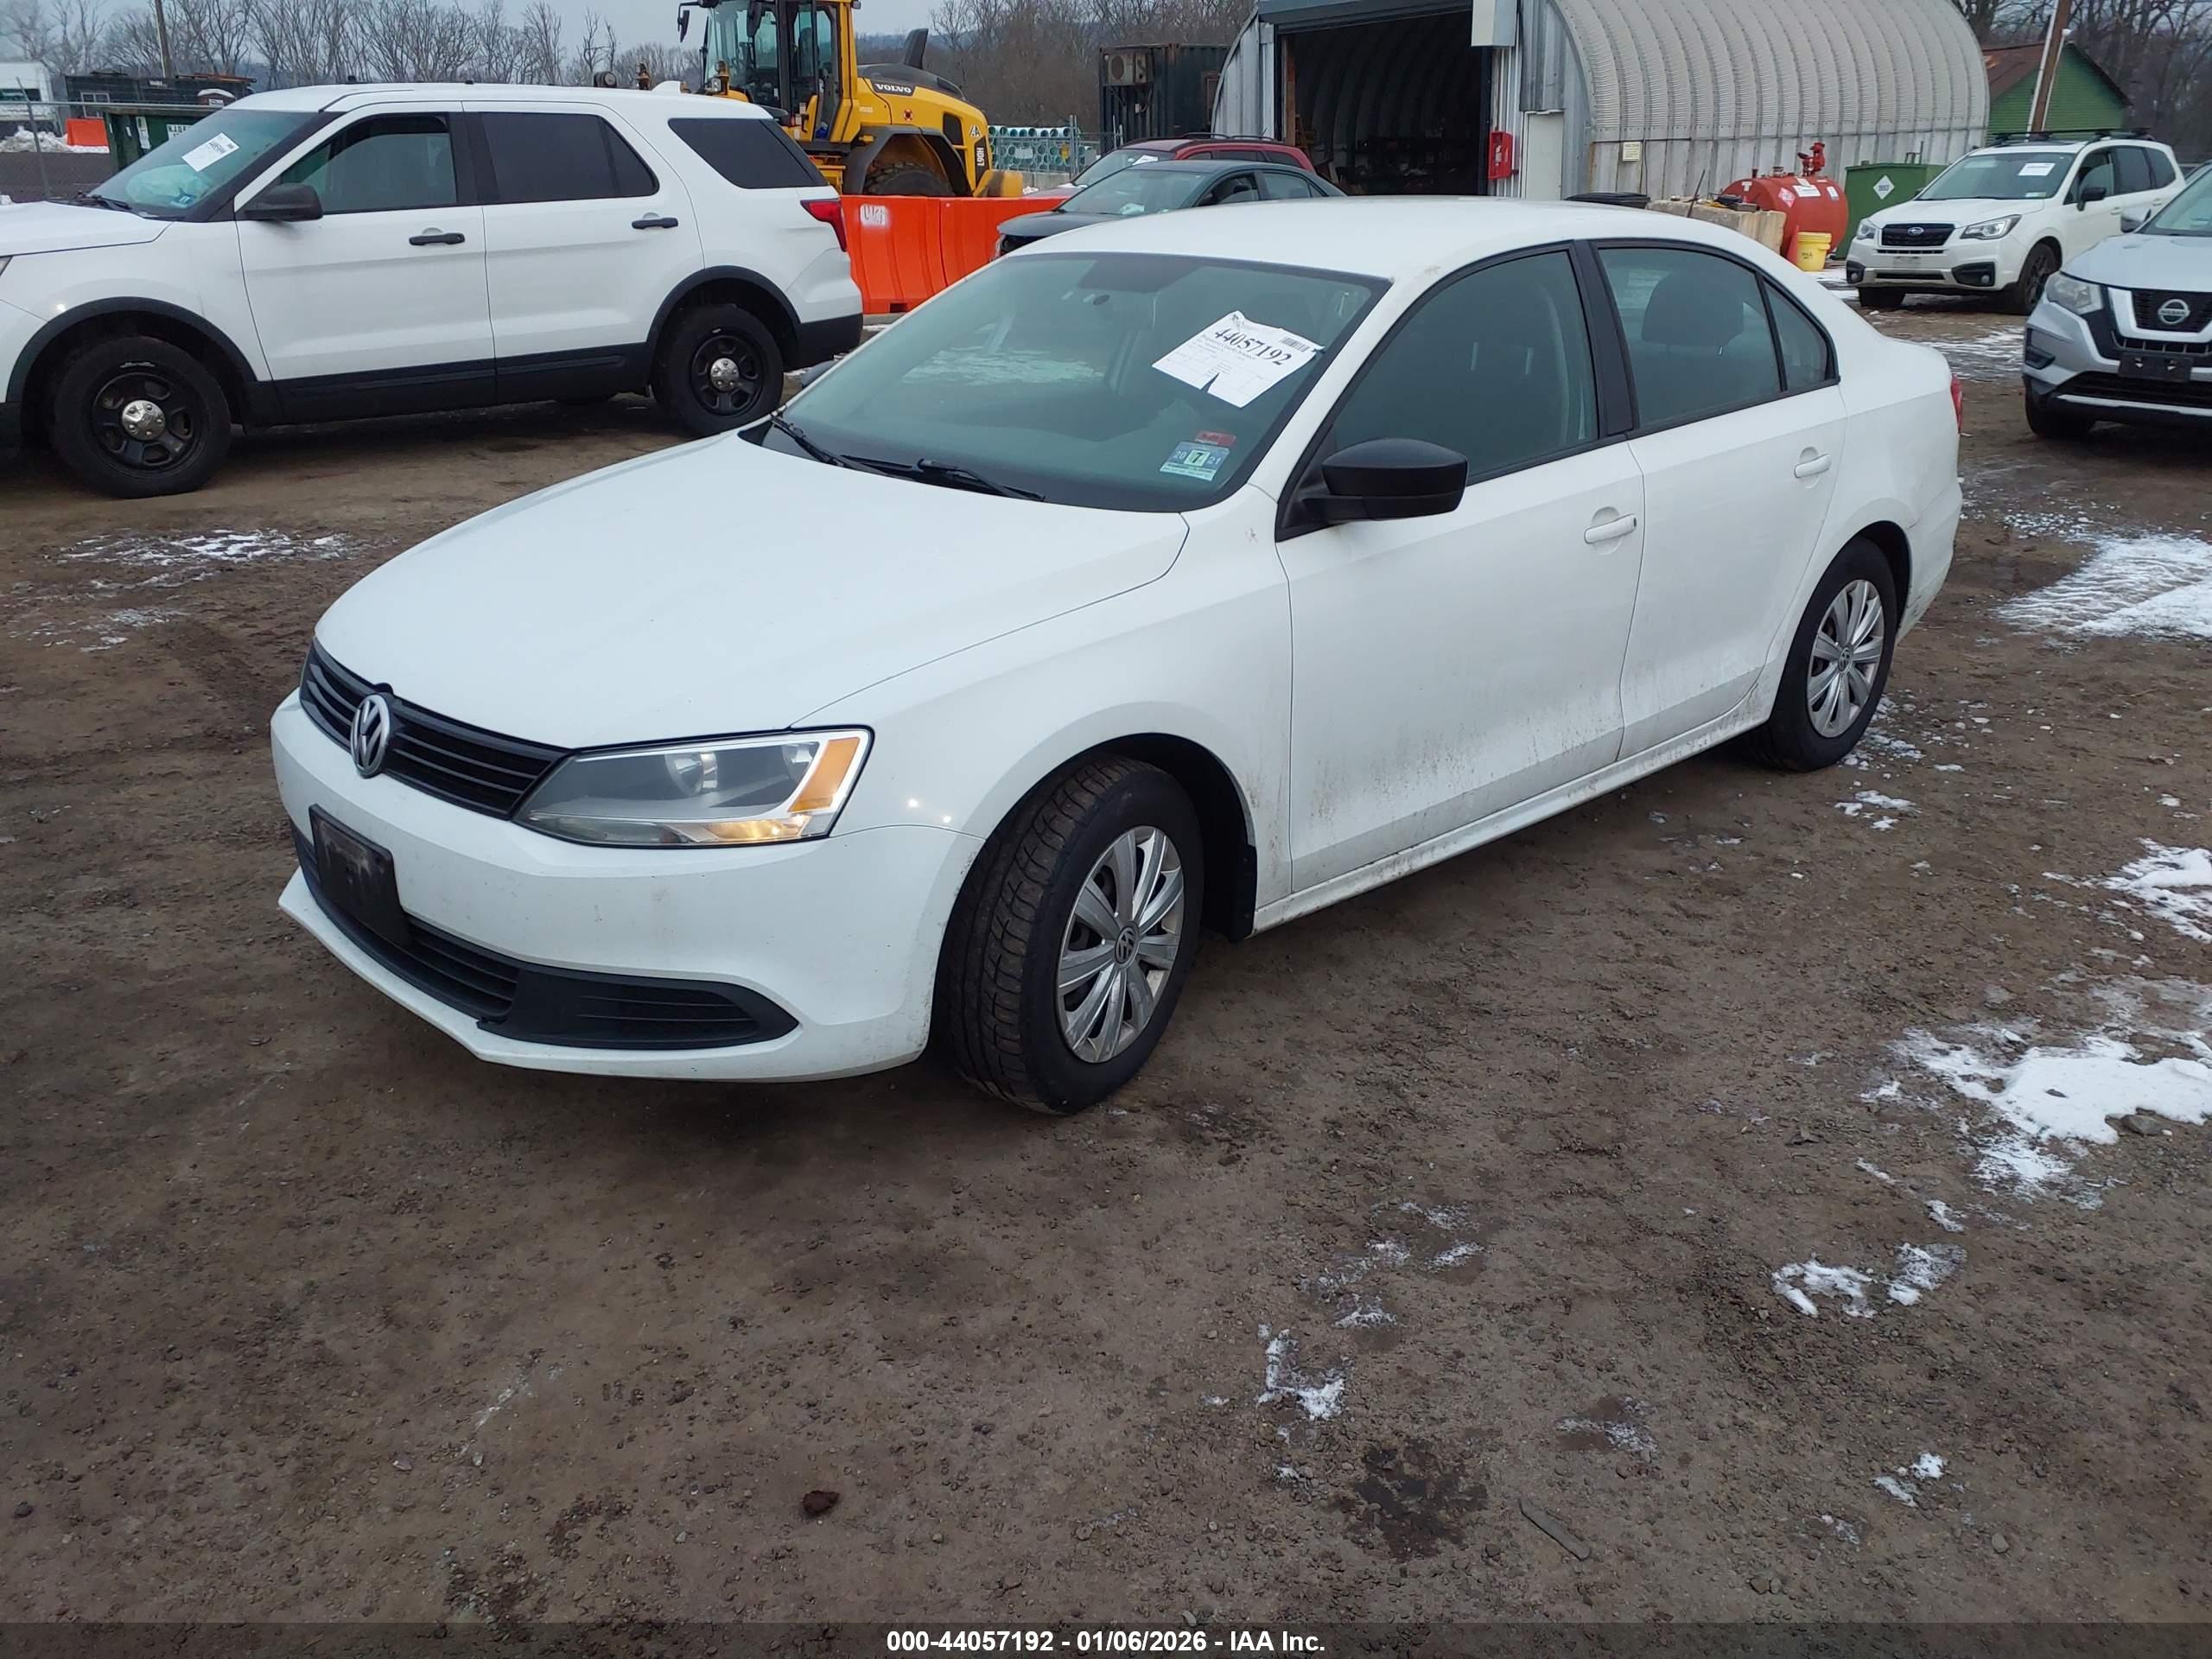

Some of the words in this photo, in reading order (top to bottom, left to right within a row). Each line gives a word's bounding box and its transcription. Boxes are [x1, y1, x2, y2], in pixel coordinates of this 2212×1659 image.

[874, 83, 912, 93] VOLVO
[976, 147, 985, 166] L90H
[1214, 328, 1292, 365] 44057192
[1192, 452, 1205, 464] 7
[1206, 456, 1222, 465] 21
